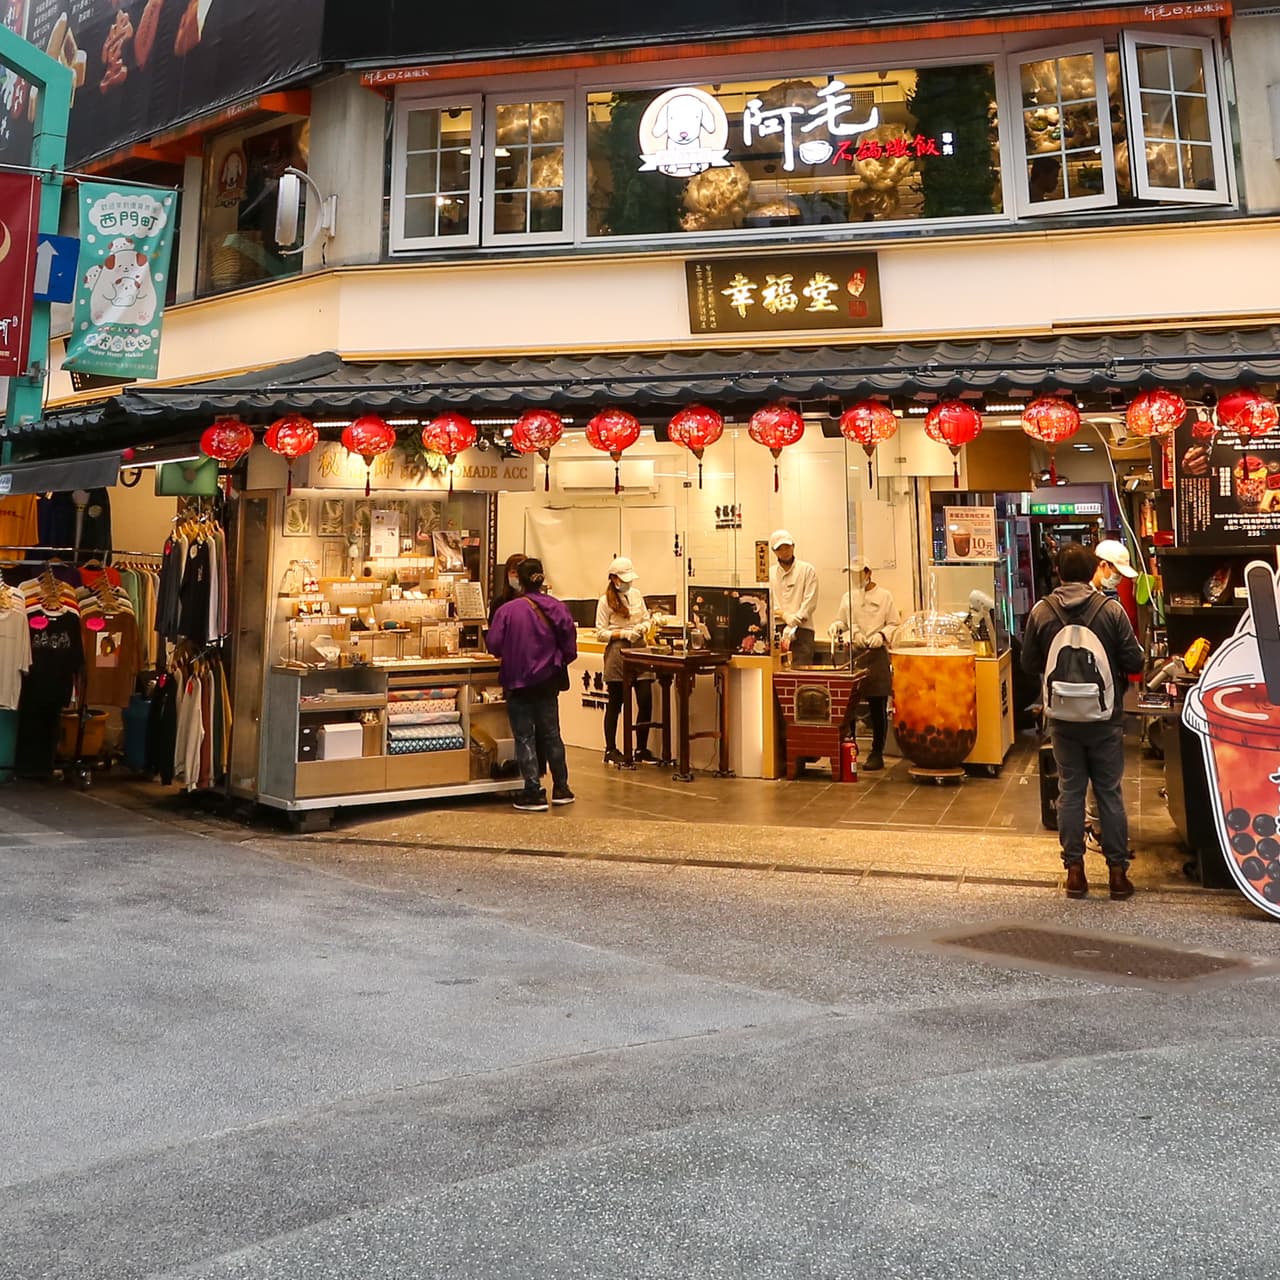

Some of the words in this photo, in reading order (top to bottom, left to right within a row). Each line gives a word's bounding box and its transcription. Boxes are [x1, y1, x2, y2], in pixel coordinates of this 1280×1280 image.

[743, 80, 878, 171] 阿毛
[100, 211, 158, 230] 西門町
[721, 272, 839, 319] 幸福堂
[503, 469, 528, 480] ACC
